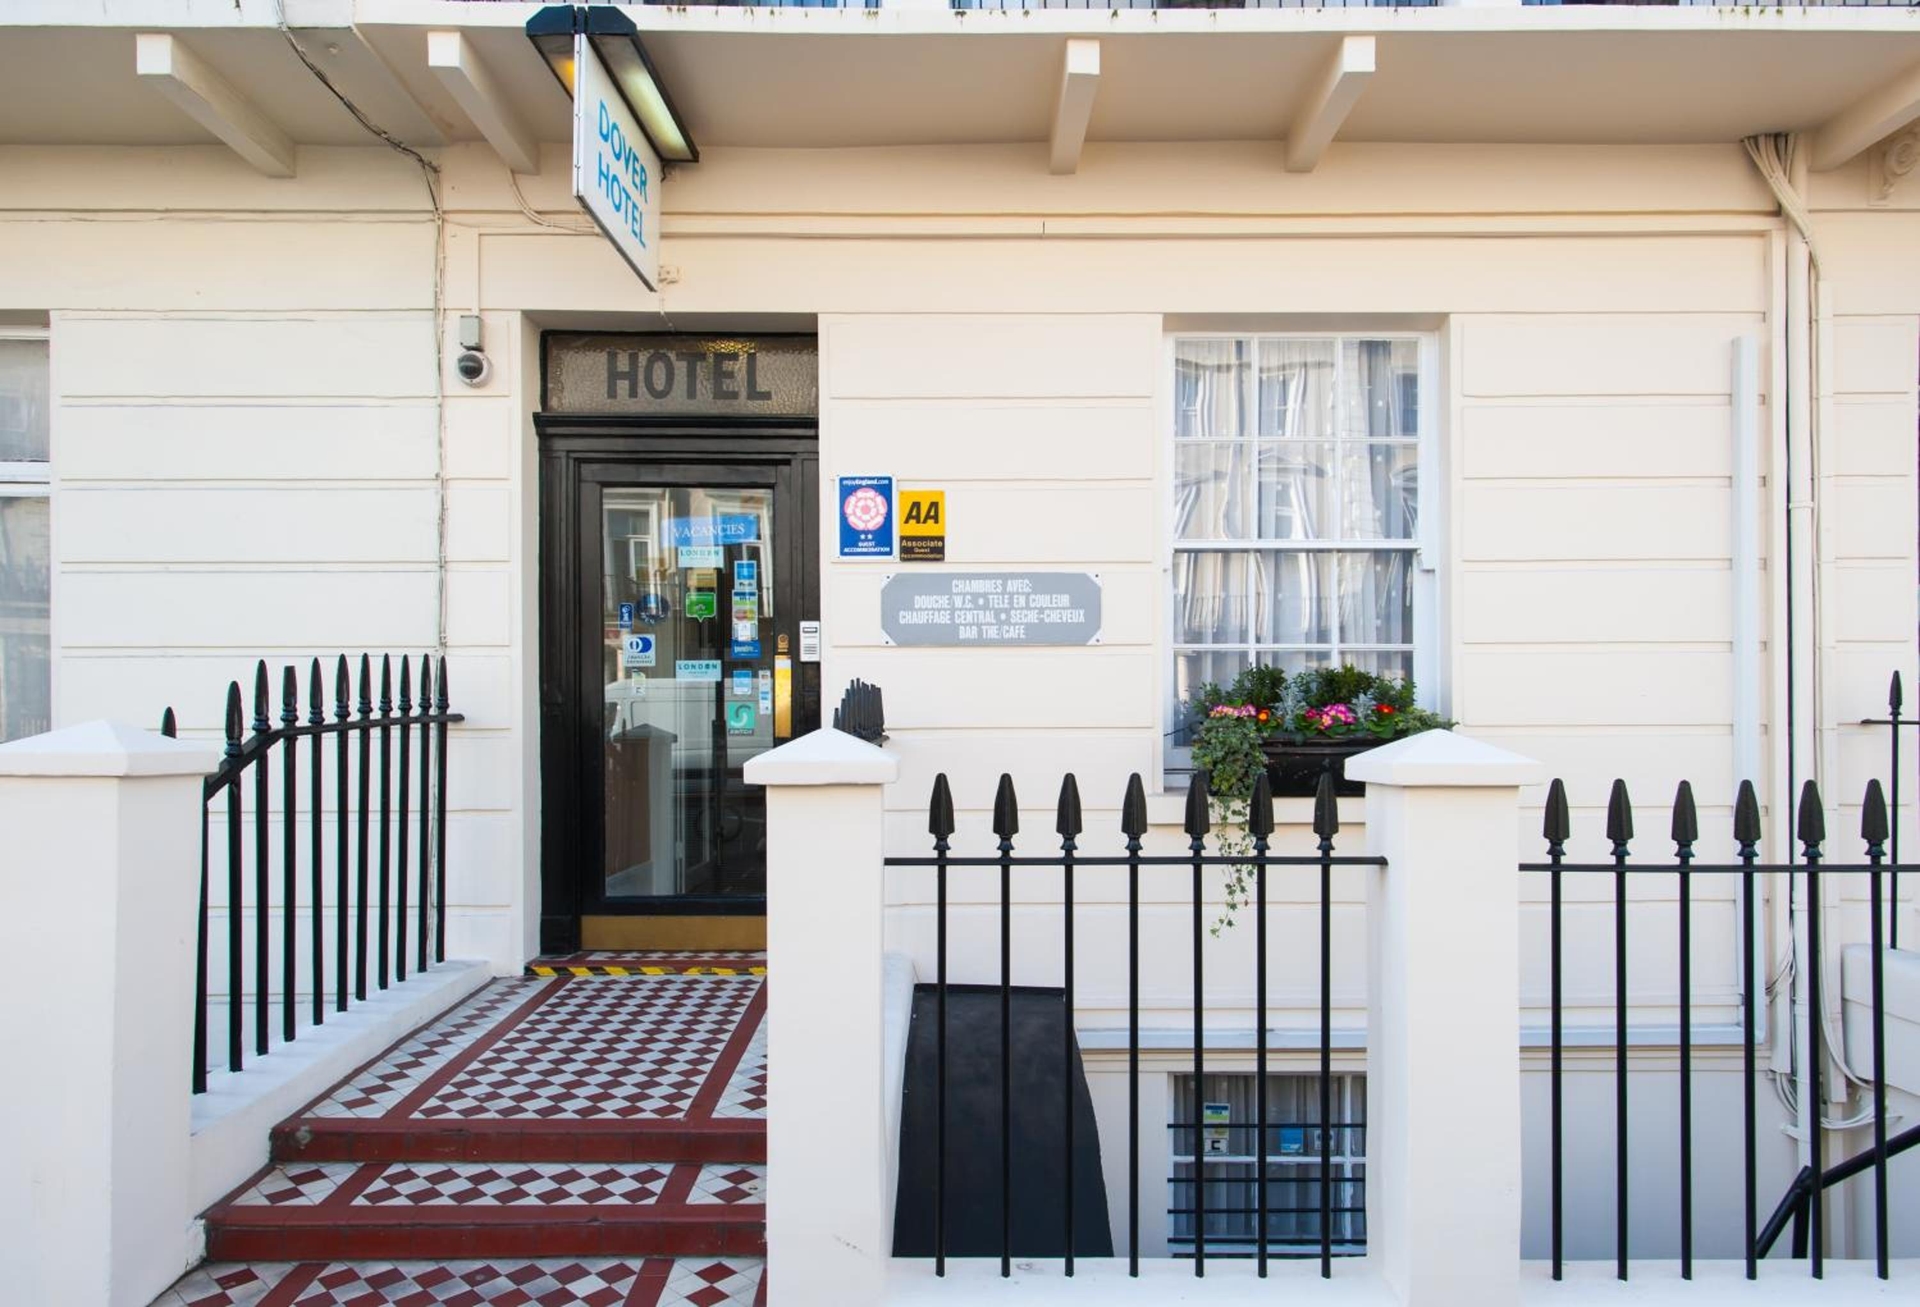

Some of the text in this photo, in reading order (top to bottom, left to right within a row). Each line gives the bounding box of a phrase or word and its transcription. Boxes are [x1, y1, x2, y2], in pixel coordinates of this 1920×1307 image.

[600, 100, 648, 204] DOVER
[599, 152, 646, 249] HOTEL
[606, 350, 773, 401] HOTEL
[903, 501, 940, 525] AA
[674, 522, 745, 539] VACANCIES
[901, 540, 943, 548] Associate
[952, 579, 1003, 593] CHAMBRES
[988, 594, 1010, 608] TELE
[1013, 594, 1026, 608] EN
[1029, 594, 1070, 608] COULEUR
[899, 609, 951, 624] CHAUFFAGE
[954, 609, 996, 624] CENTRAL
[959, 625, 978, 639] BAR
